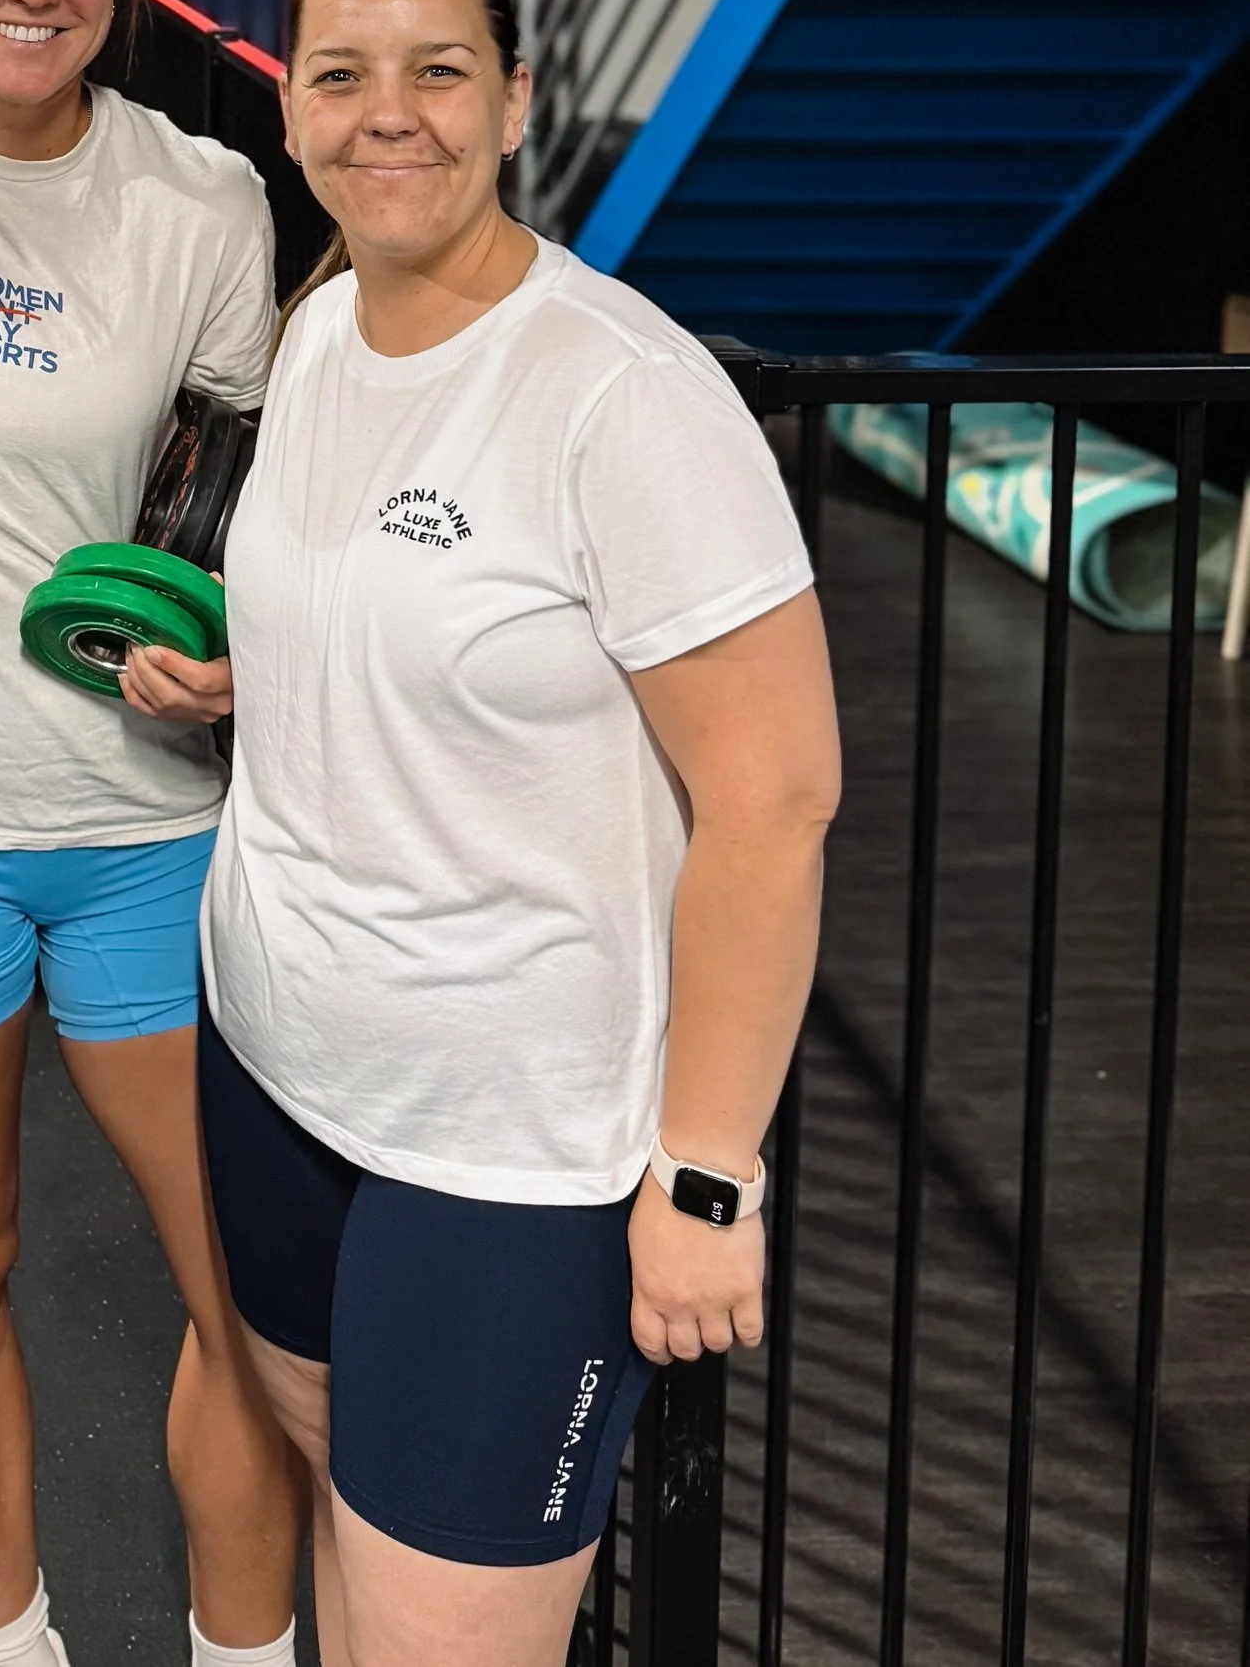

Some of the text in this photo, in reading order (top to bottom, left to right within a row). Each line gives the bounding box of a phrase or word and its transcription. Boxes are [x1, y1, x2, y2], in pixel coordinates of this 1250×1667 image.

[378, 488, 473, 540] LORNA JANE
[403, 510, 441, 530] LUXE
[380, 521, 453, 549] ATHLETIC
[543, 1359, 604, 1522] LORNA JANE
